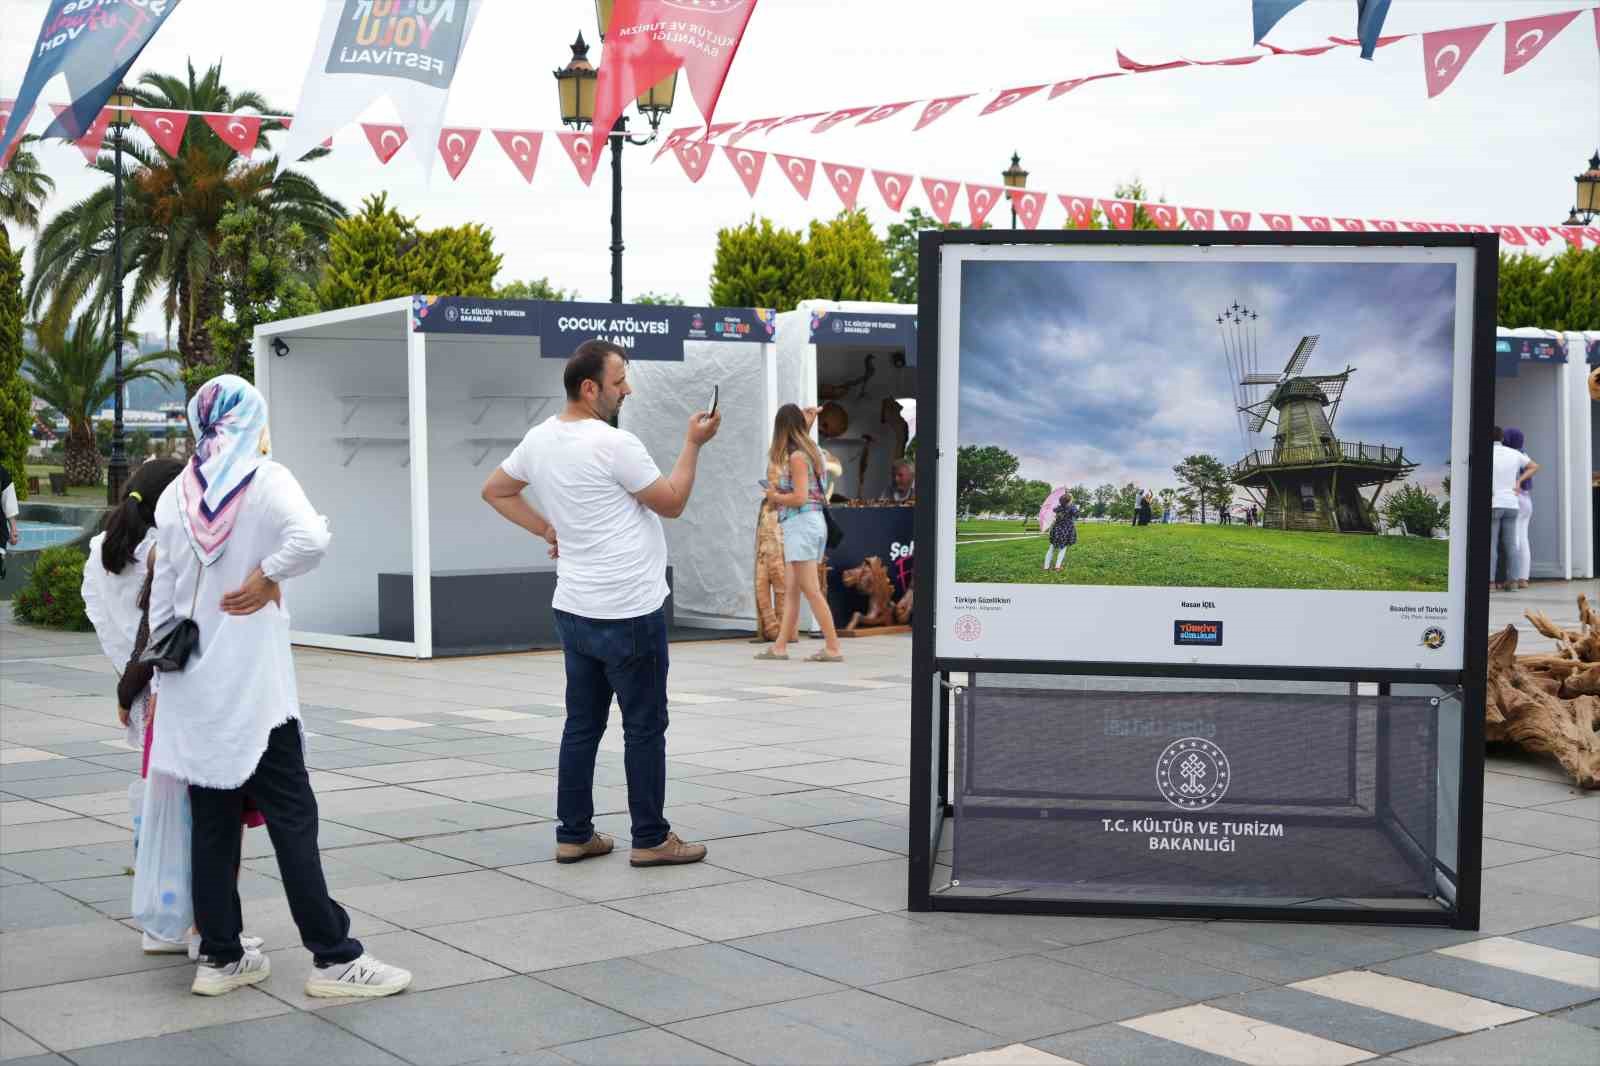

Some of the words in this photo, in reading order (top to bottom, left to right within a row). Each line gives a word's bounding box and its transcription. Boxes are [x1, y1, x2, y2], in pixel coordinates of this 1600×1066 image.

[558, 316, 606, 332] ÇOCUK
[609, 317, 669, 334] ATÖLYESİ
[1101, 819, 1129, 832] T.C.
[1132, 817, 1194, 834] KÜLTÜR
[1198, 821, 1218, 835] VE
[1221, 820, 1284, 836] TURİZM
[1149, 836, 1236, 852] BAKANLIĞI
